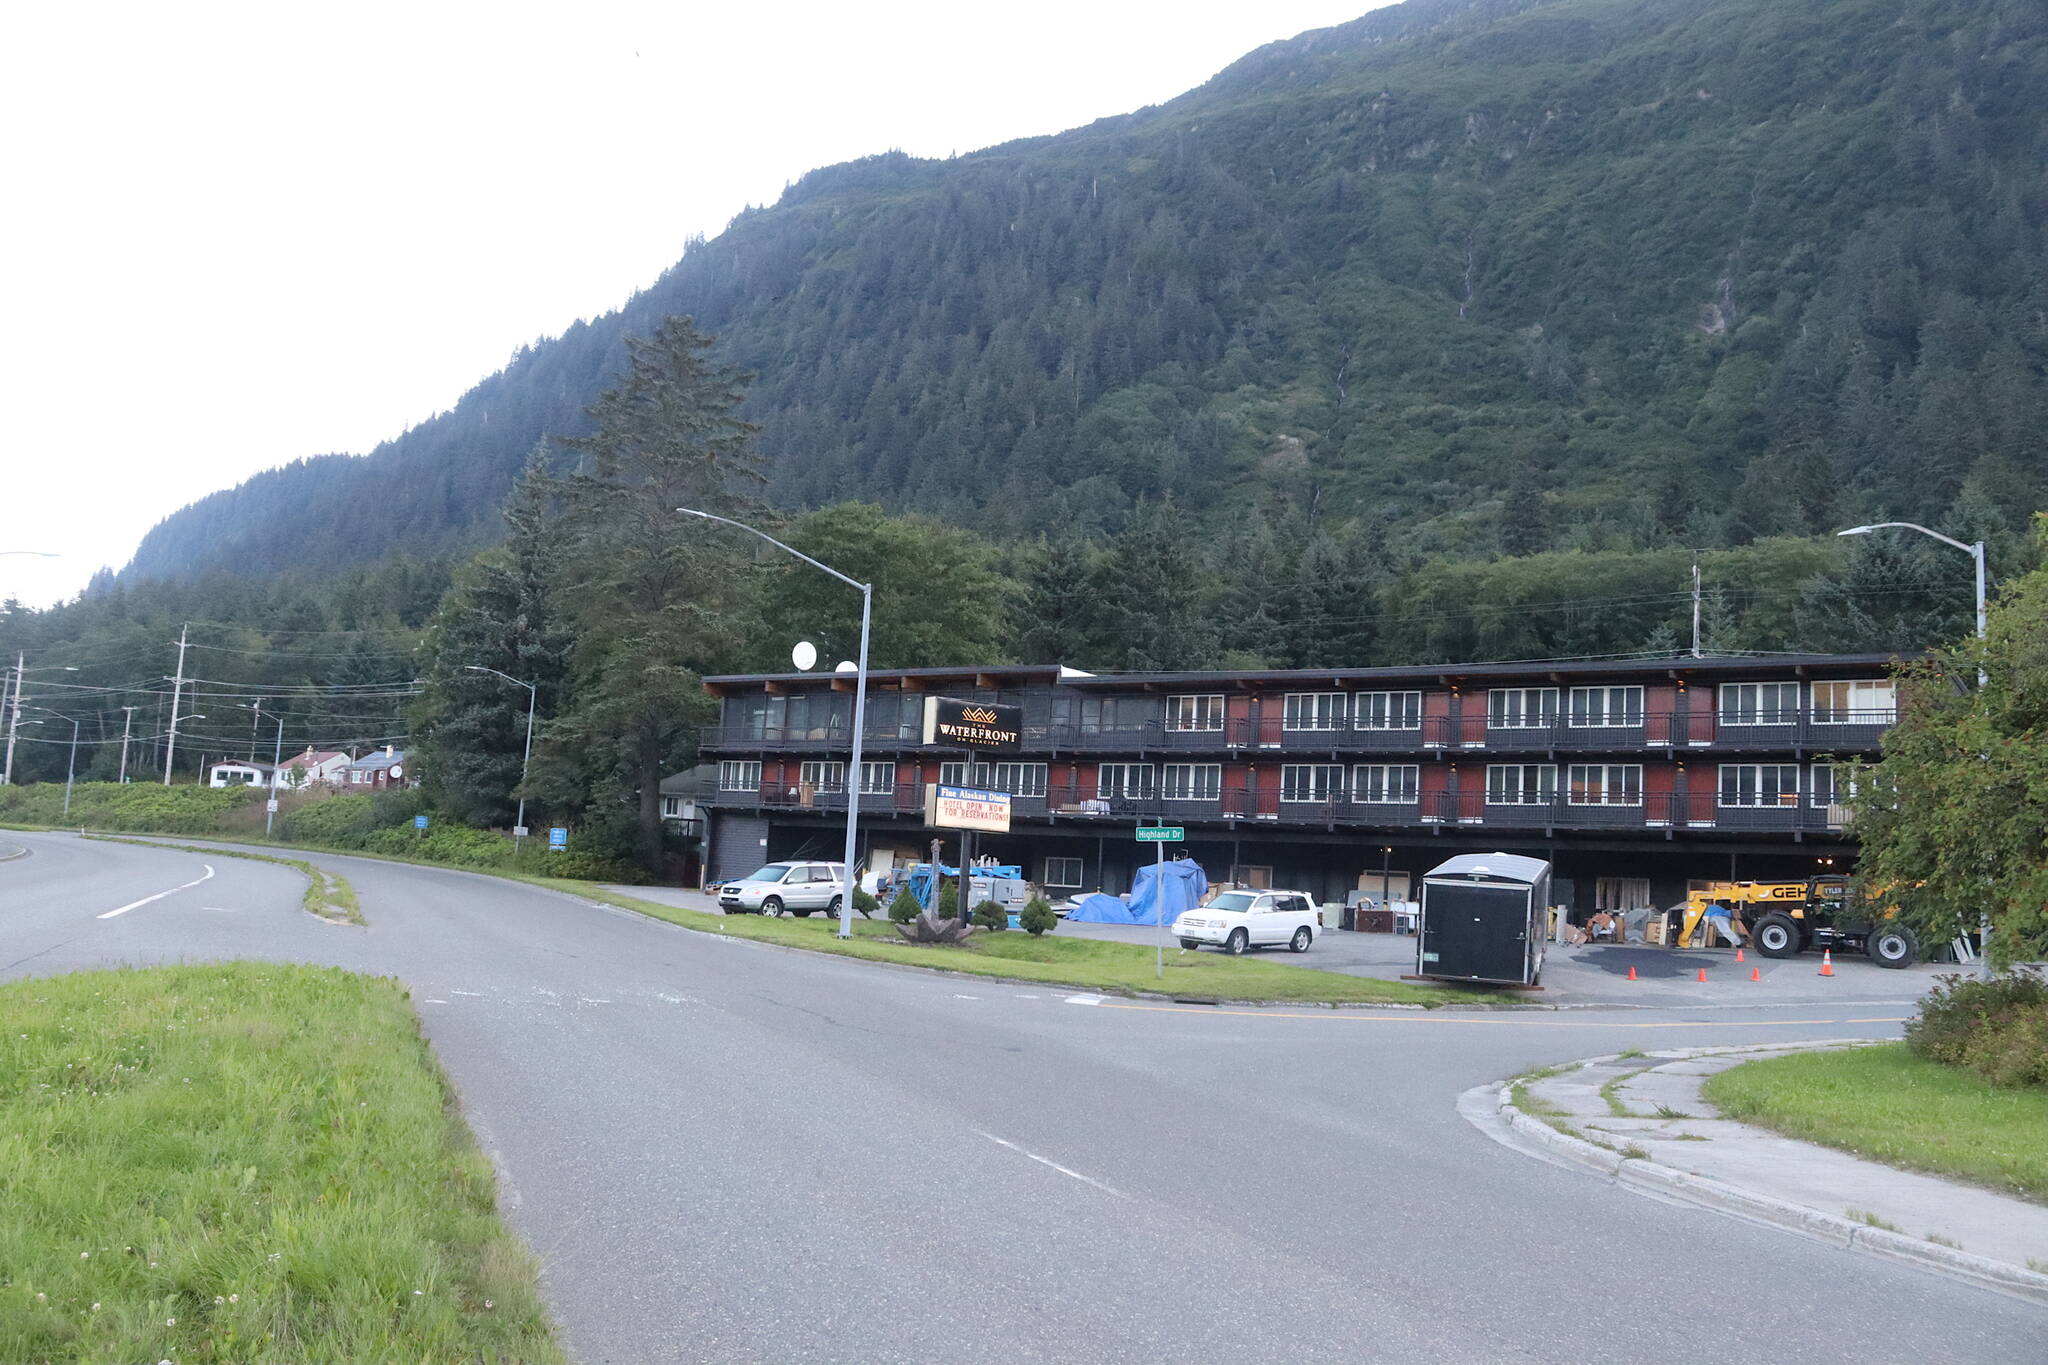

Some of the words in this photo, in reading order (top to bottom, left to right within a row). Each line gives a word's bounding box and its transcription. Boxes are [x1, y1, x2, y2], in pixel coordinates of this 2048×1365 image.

[939, 724, 1017, 743] WATERFRONT
[941, 787, 957, 798] Fine
[959, 790, 987, 801] Alaskan
[989, 793, 1010, 803] Dining
[944, 799, 963, 809] HOTEL
[966, 802, 982, 811] OPEN
[989, 804, 1004, 812] NOW
[945, 808, 958, 816] FOR
[1138, 830, 1170, 840] Highland
[1172, 830, 1181, 838] Dr
